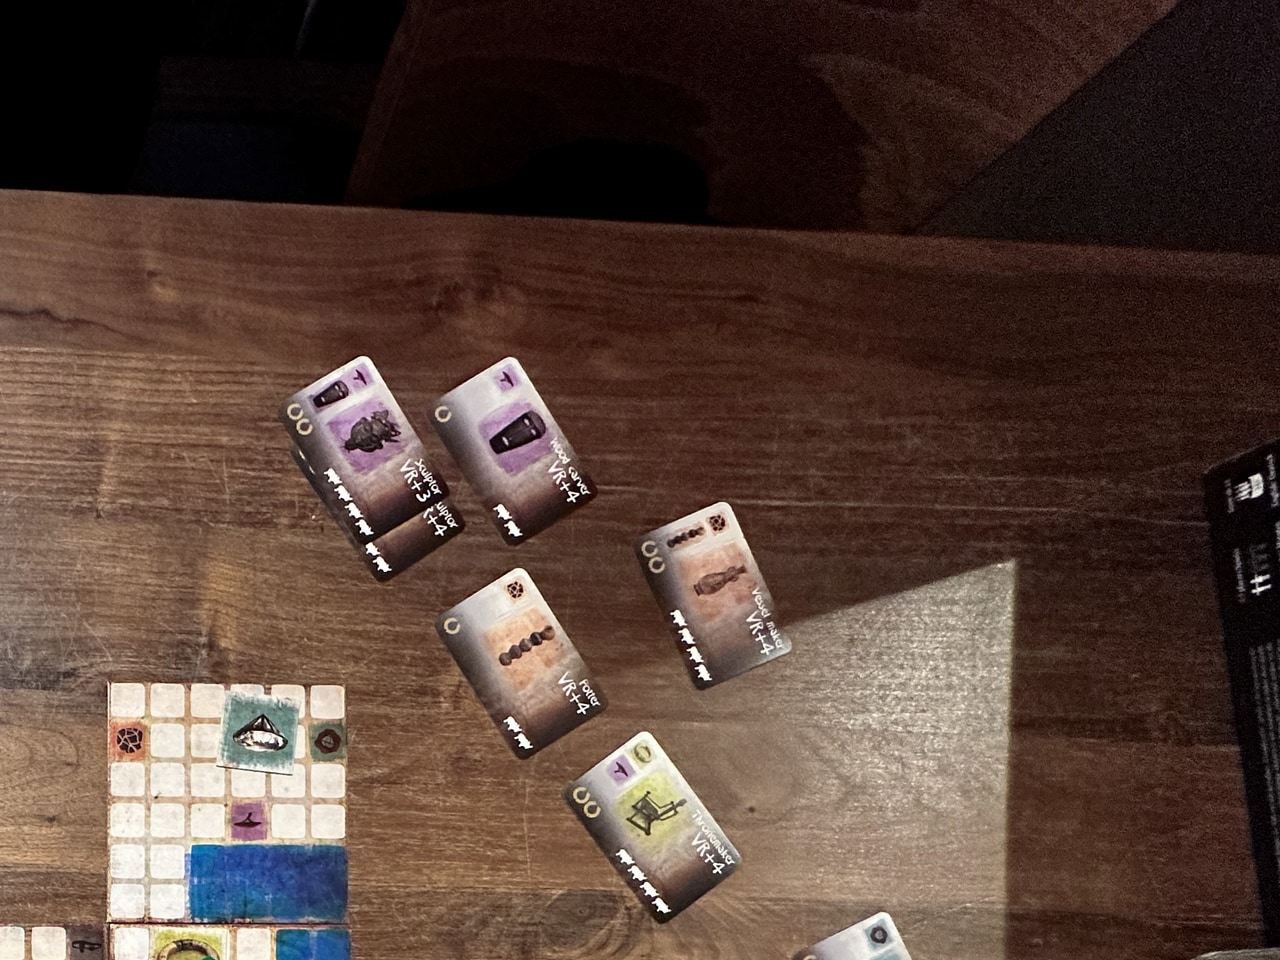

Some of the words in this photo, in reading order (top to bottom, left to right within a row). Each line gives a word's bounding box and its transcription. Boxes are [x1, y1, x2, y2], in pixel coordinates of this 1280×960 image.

[400, 459, 432, 503] VR+3
[414, 458, 443, 496] Sculptor
[548, 460, 580, 503] VR+4
[550, 437, 571, 465] Wood
[568, 466, 592, 496] carver
[435, 501, 459, 529] ulptor
[746, 611, 776, 656] VR+4
[752, 587, 770, 619] Vessel
[765, 620, 784, 650] maker
[558, 671, 590, 715] VR+4
[579, 678, 601, 708] Potter
[691, 831, 725, 874] VR+4
[692, 809, 736, 865] Thronemaker
